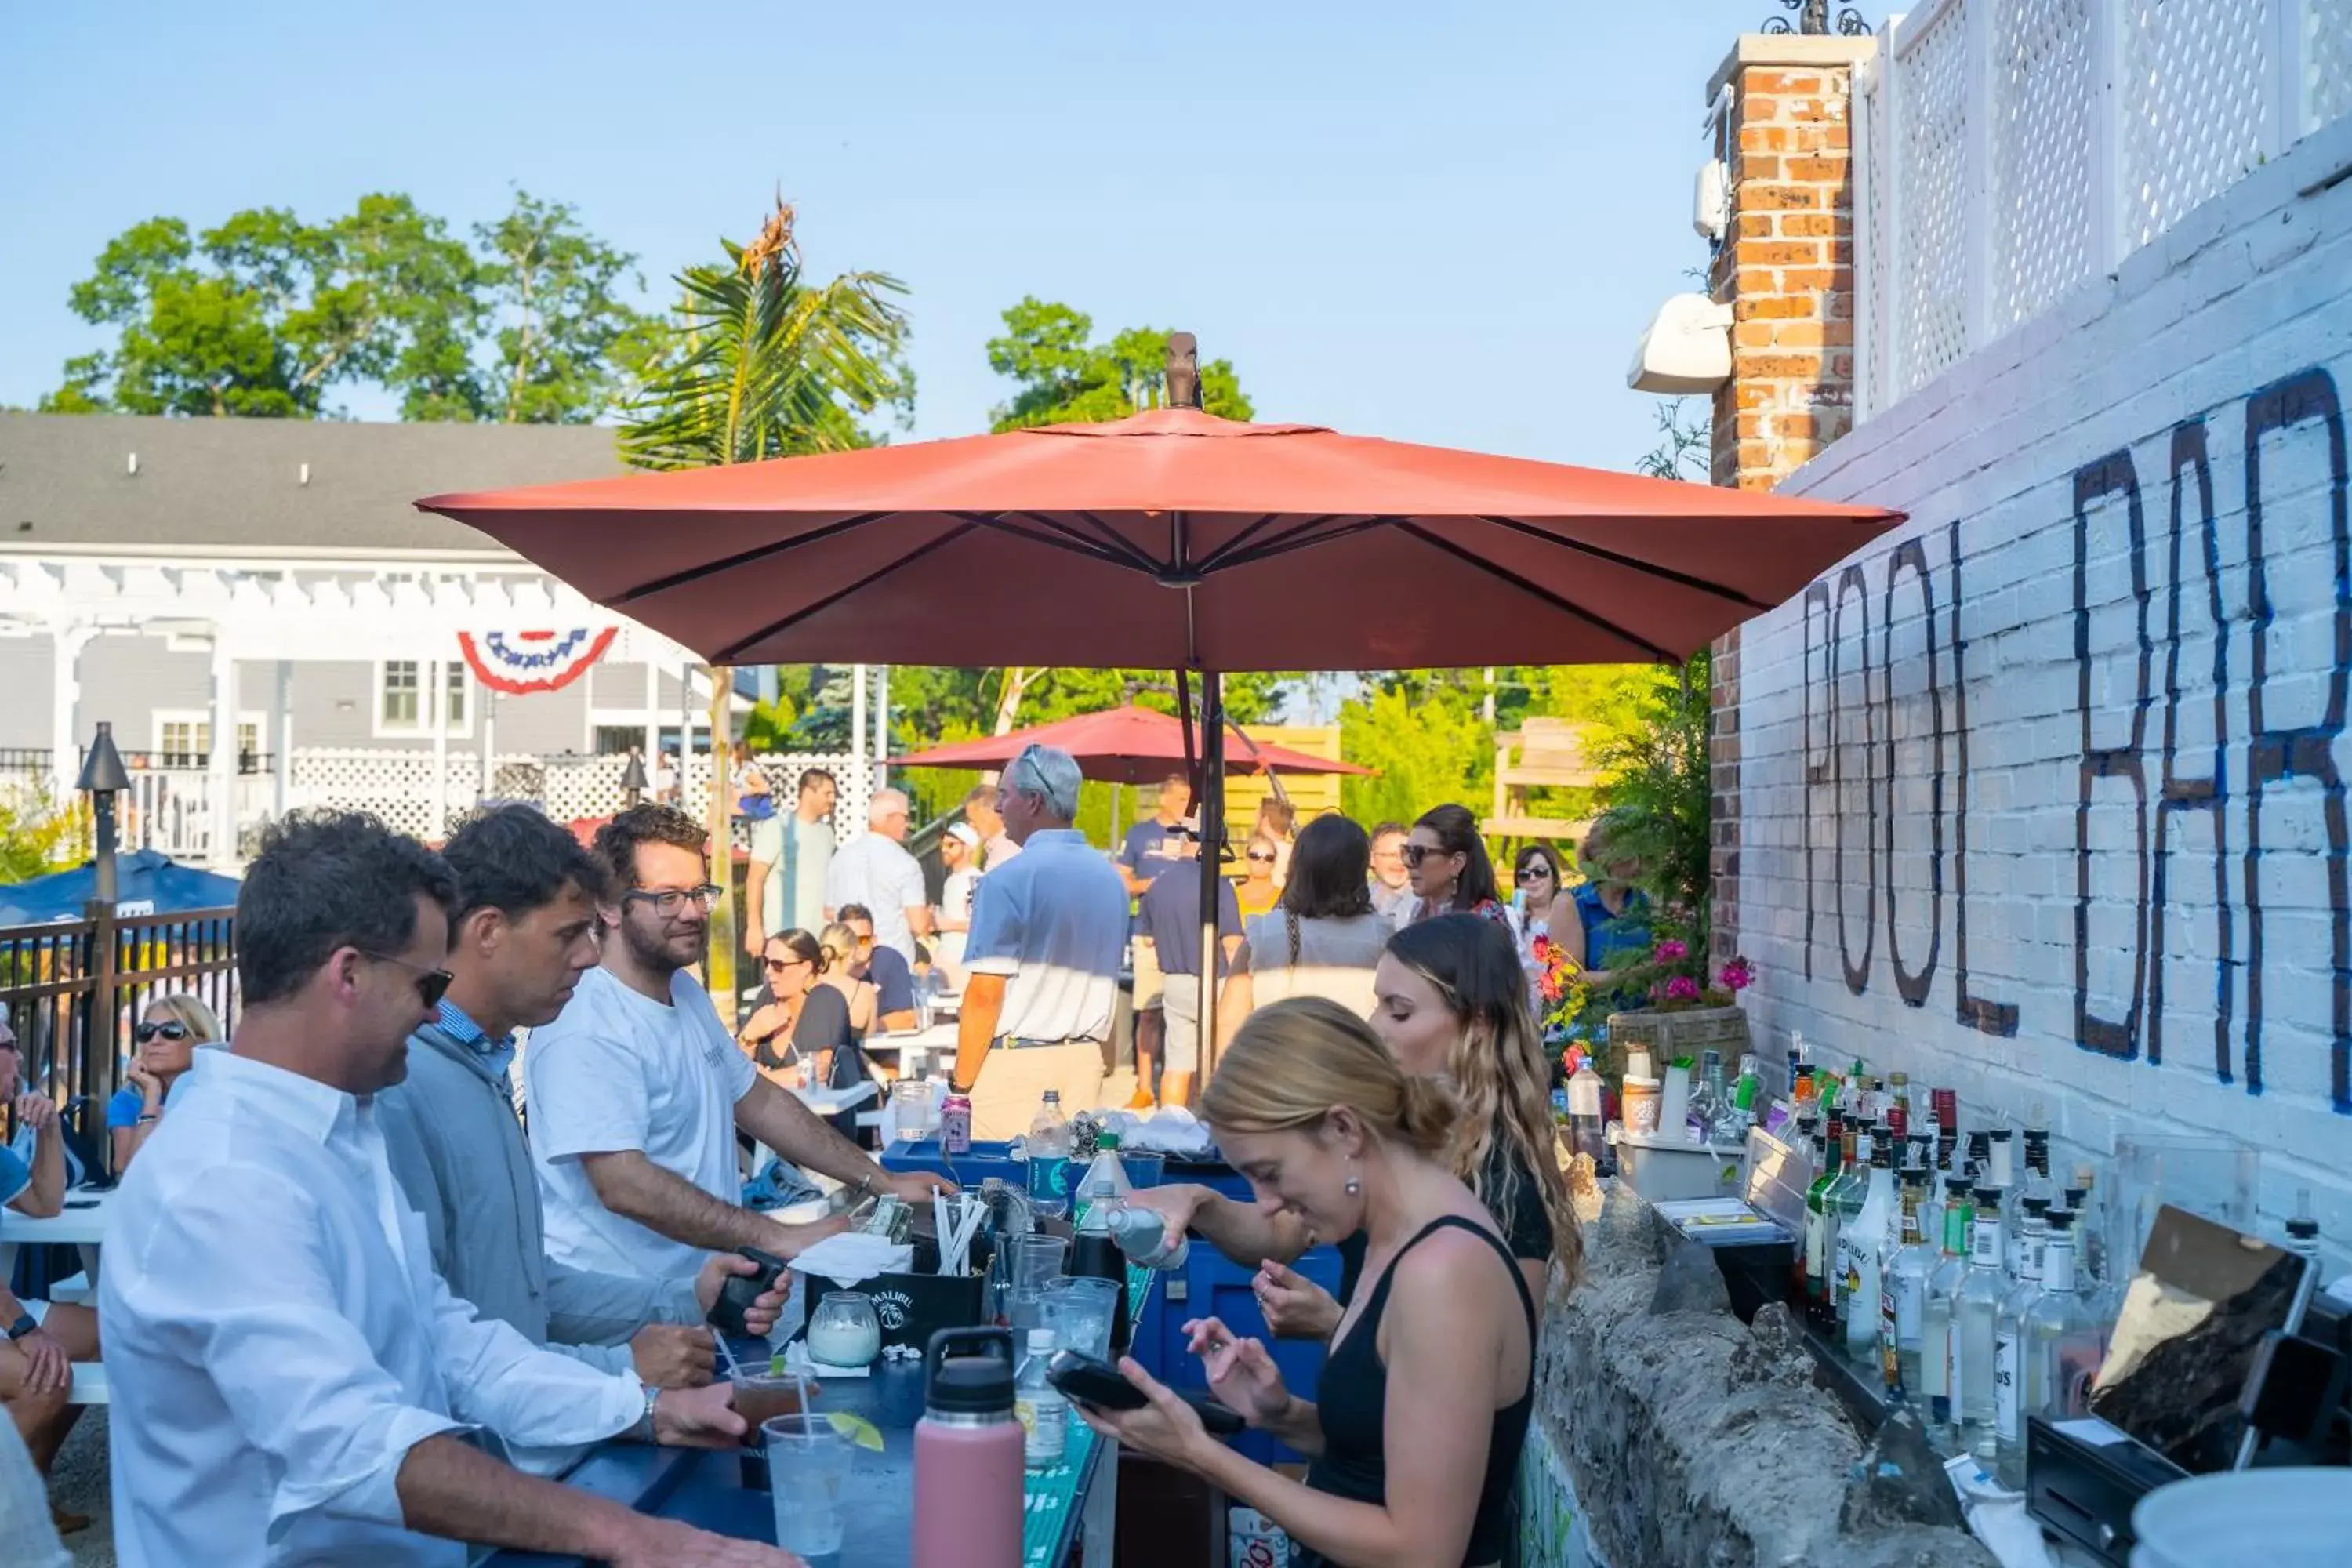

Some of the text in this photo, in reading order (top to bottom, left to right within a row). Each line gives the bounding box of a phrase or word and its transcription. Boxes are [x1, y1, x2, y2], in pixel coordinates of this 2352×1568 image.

[1804, 365, 2352, 1114] POOL BAR
[871, 1290, 914, 1308] MALIBU
